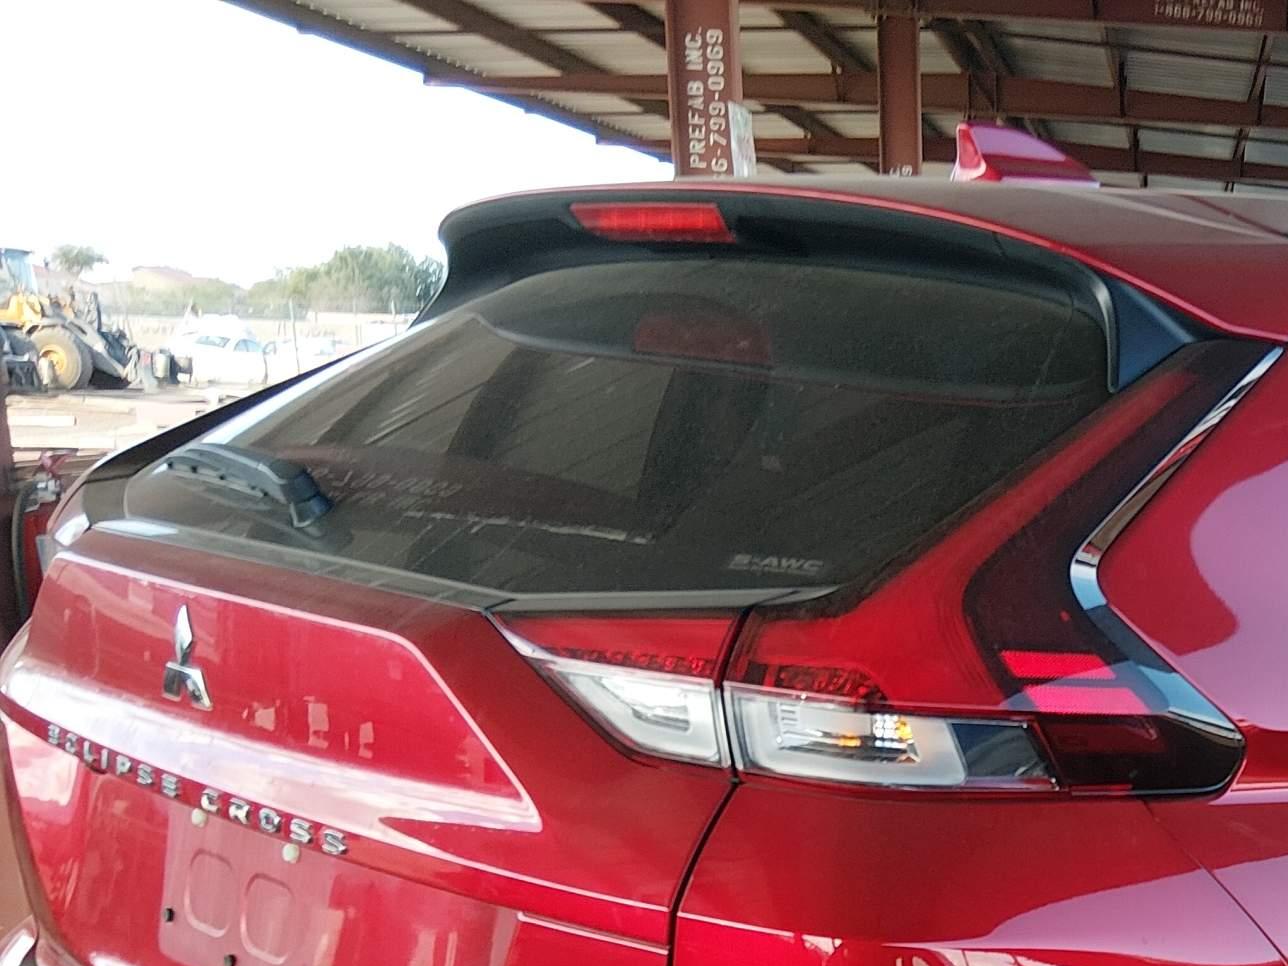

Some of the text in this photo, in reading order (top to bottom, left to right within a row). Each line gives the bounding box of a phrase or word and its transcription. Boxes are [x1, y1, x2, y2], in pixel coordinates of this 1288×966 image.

[685, 27, 707, 169] PREFAB INC.
[47, 723, 347, 856] ECLIPSE CROSS
